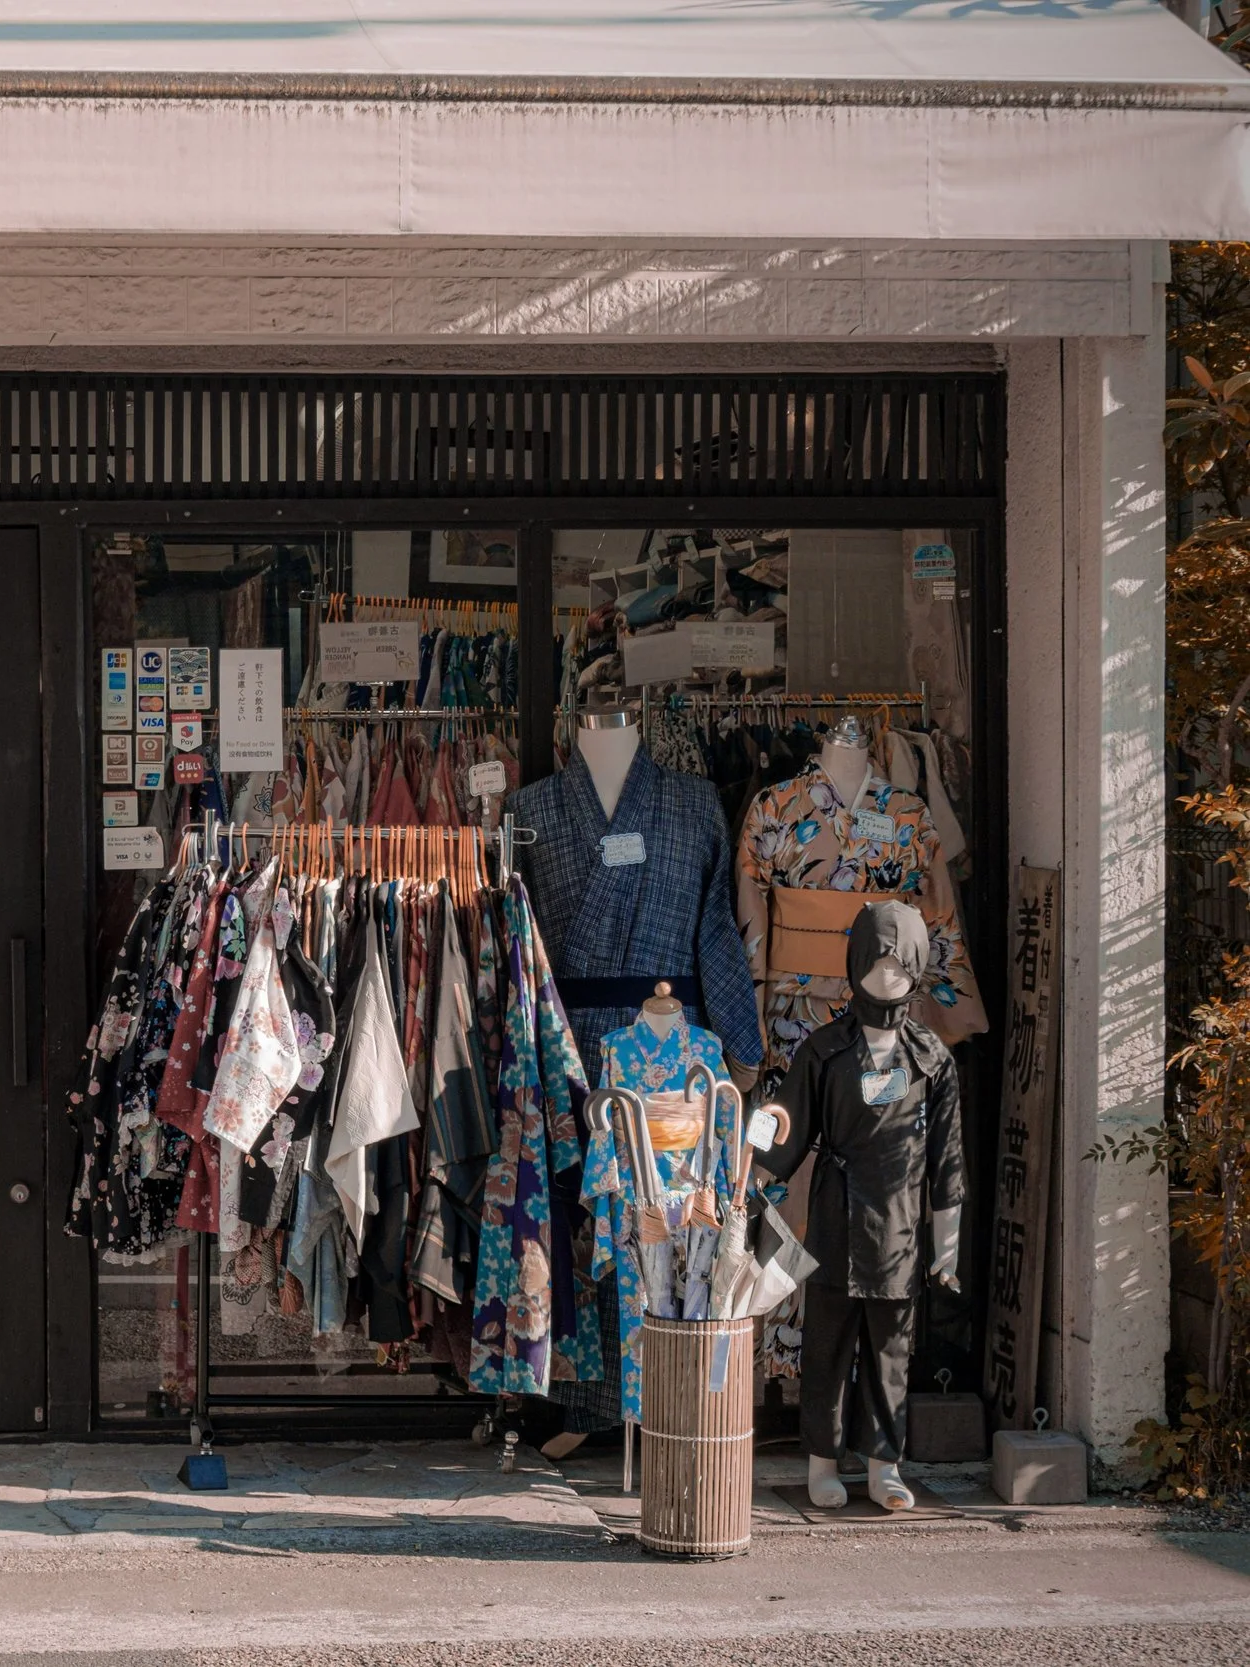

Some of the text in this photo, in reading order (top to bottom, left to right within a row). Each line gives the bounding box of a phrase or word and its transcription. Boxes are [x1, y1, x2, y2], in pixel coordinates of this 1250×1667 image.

[142, 657, 161, 668] UC
[237, 663, 246, 722] ご遠慮ください
[255, 663, 264, 723] 軒下での飲食は
[141, 718, 164, 727] VISA
[181, 738, 193, 746] Pay
[177, 761, 201, 771] d払い
